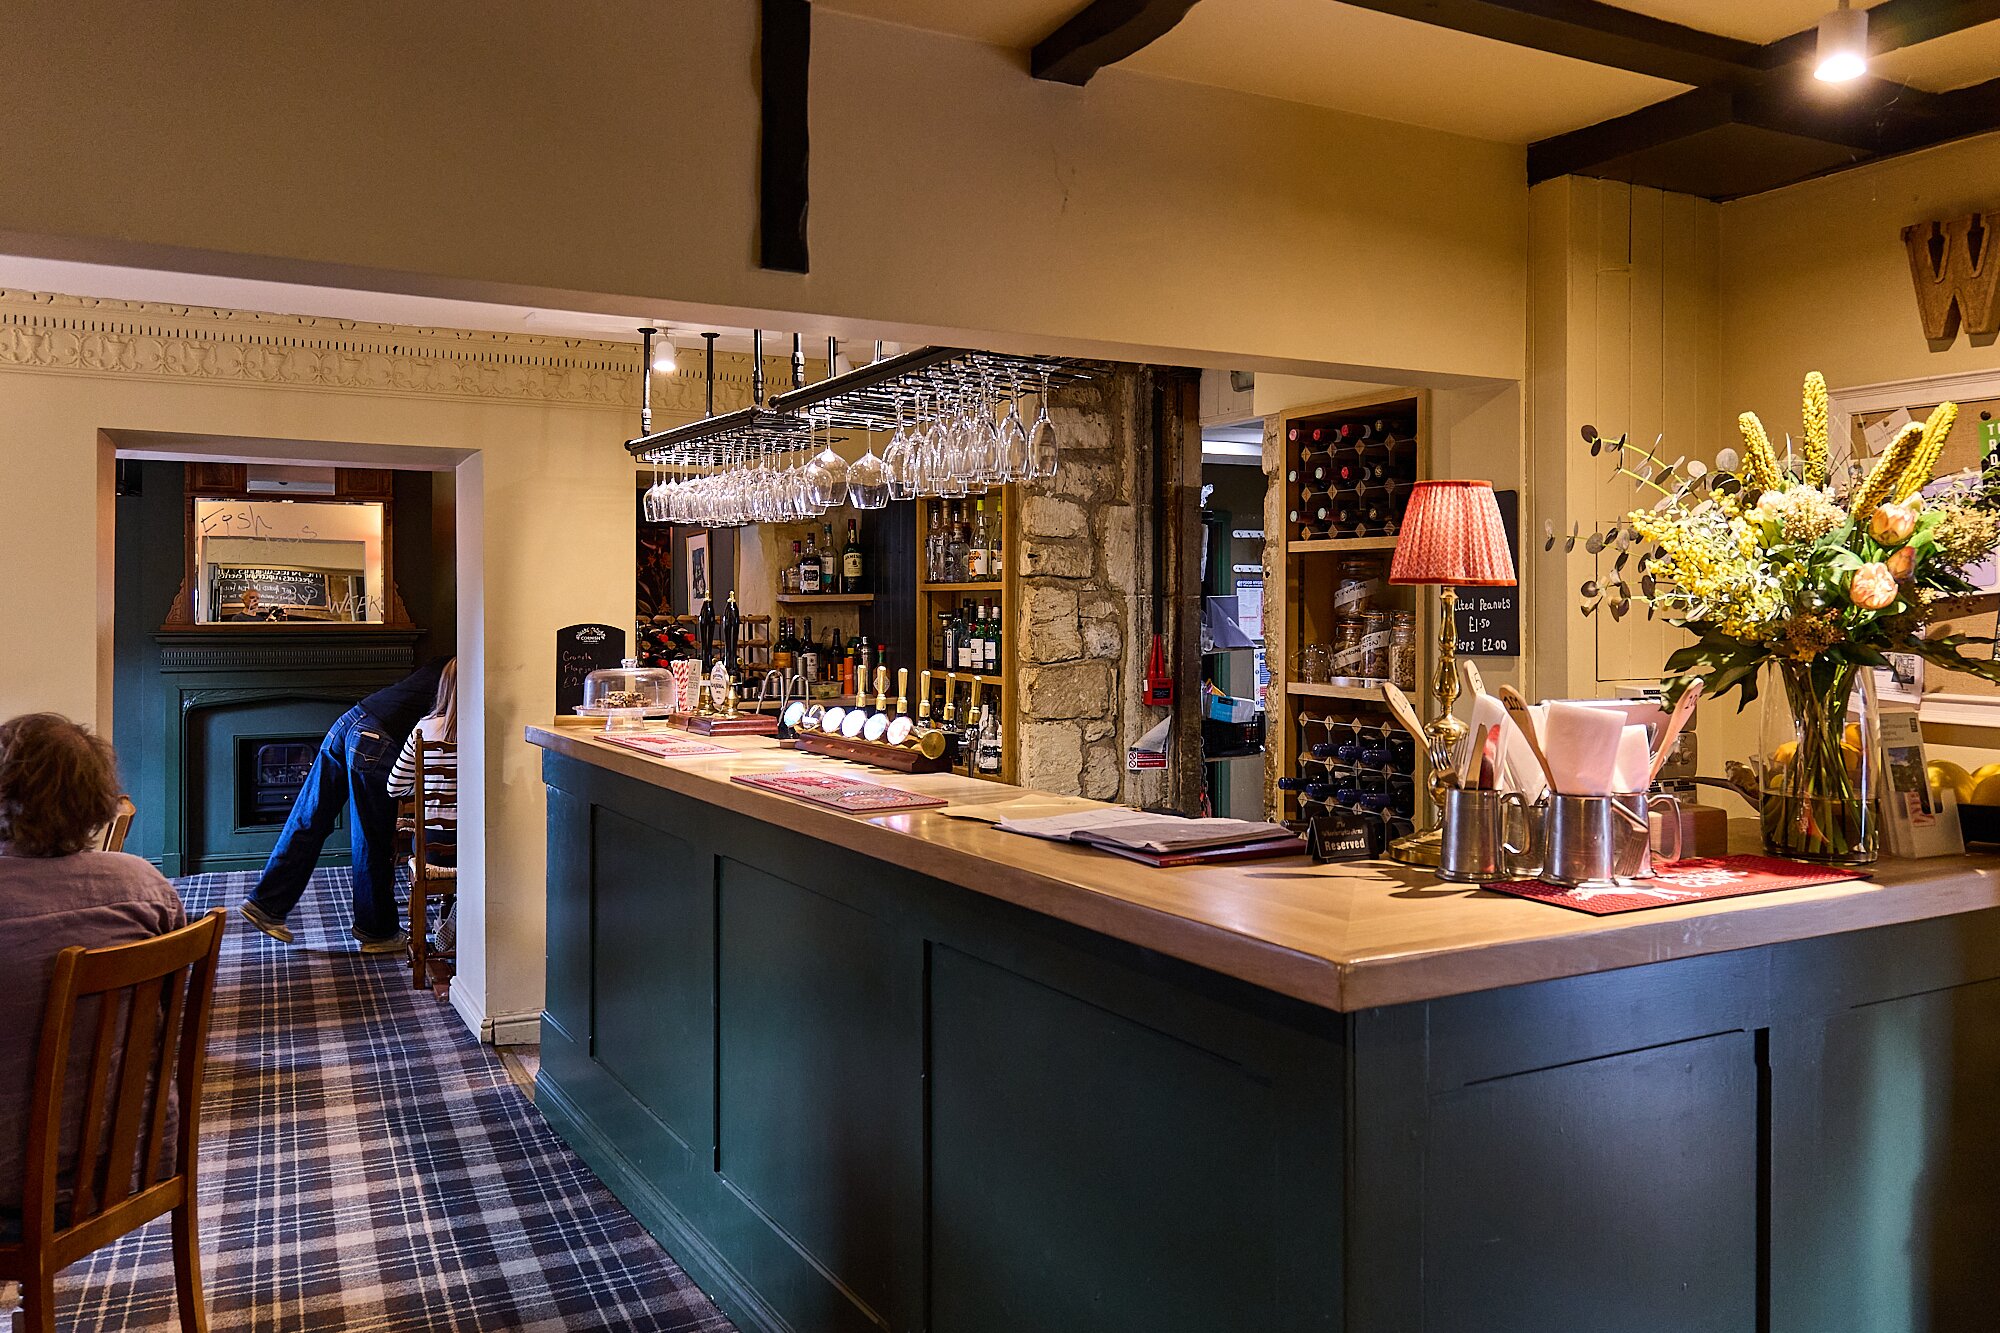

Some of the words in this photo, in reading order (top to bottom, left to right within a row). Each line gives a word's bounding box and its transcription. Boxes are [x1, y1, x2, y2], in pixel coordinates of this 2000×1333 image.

[201, 505, 273, 539] Fish
[328, 592, 381, 615] WEEK
[1455, 598, 1475, 612] lted
[1479, 598, 1511, 611] Peanuts
[1456, 639, 1475, 652] isps
[1324, 837, 1366, 852] Reserved
